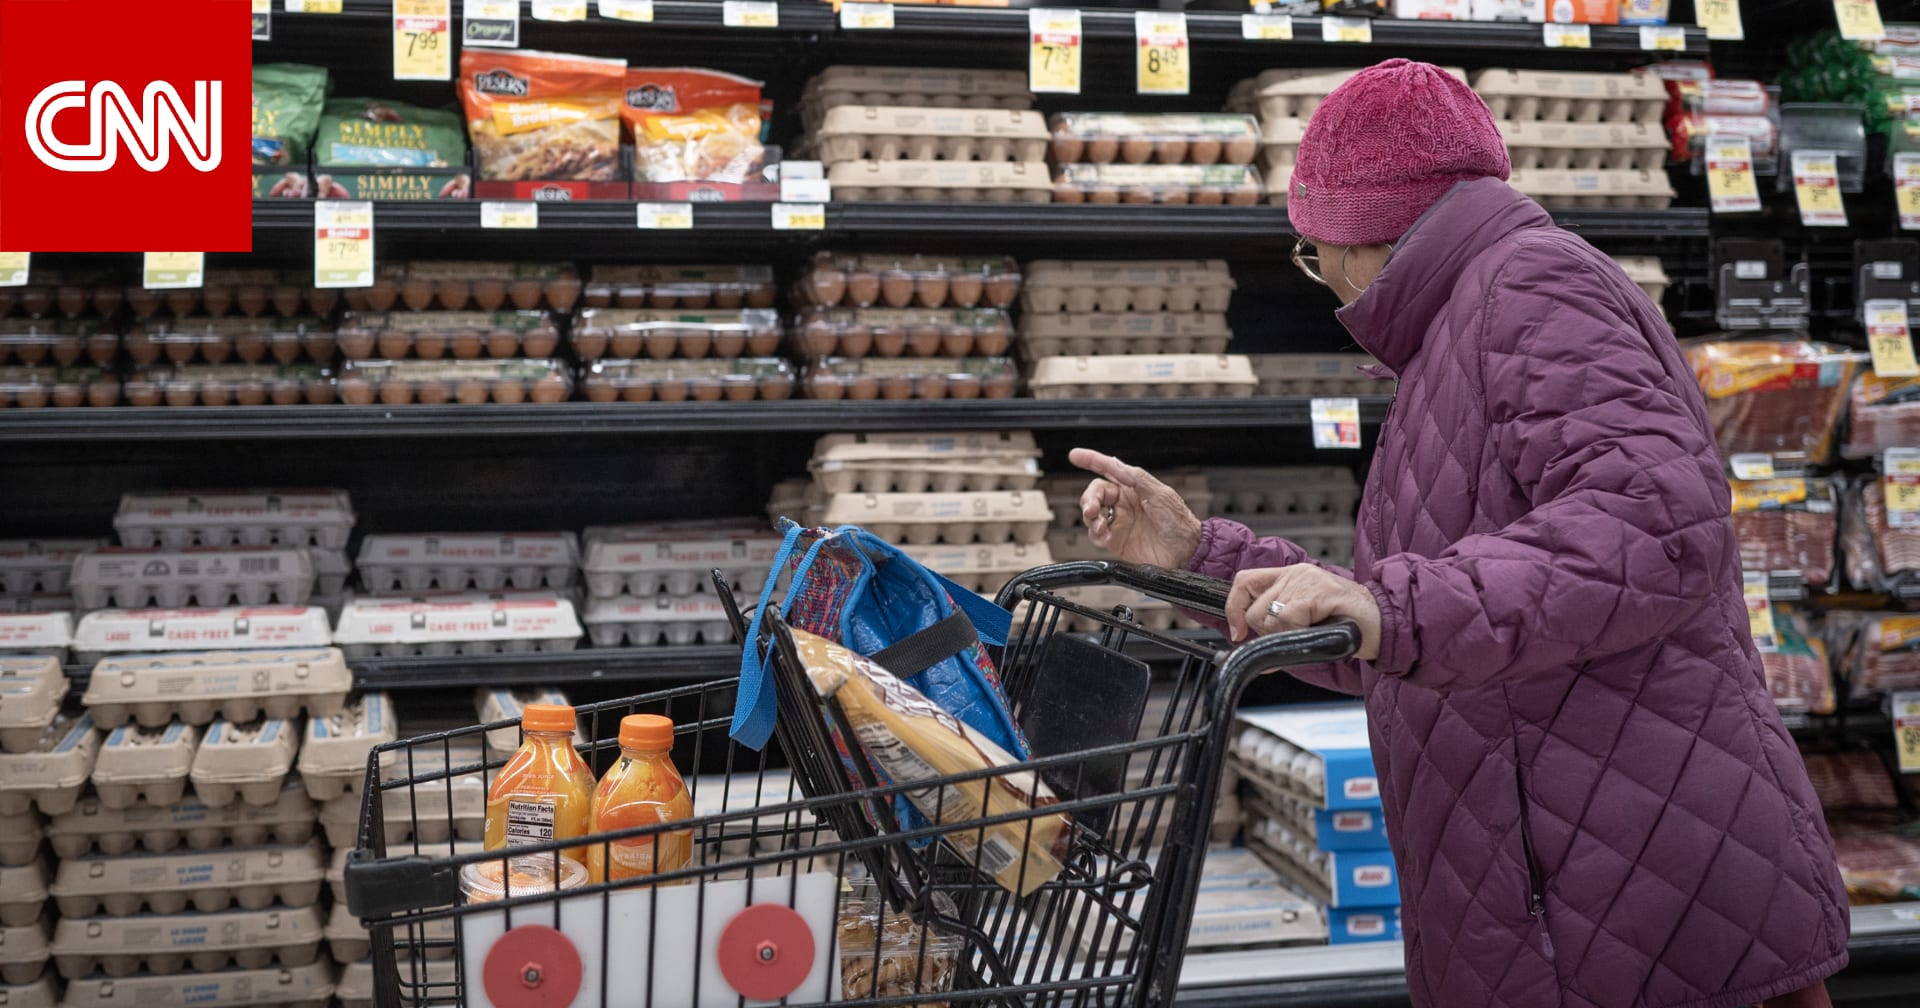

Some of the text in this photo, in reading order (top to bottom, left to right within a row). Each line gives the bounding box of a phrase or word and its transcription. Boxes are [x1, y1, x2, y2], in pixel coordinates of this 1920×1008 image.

[357, 175, 432, 191] SIMPLY
[510, 802, 554, 814] Nutrition Facts
[508, 826, 530, 835] Calories
[540, 827, 553, 837] 120
